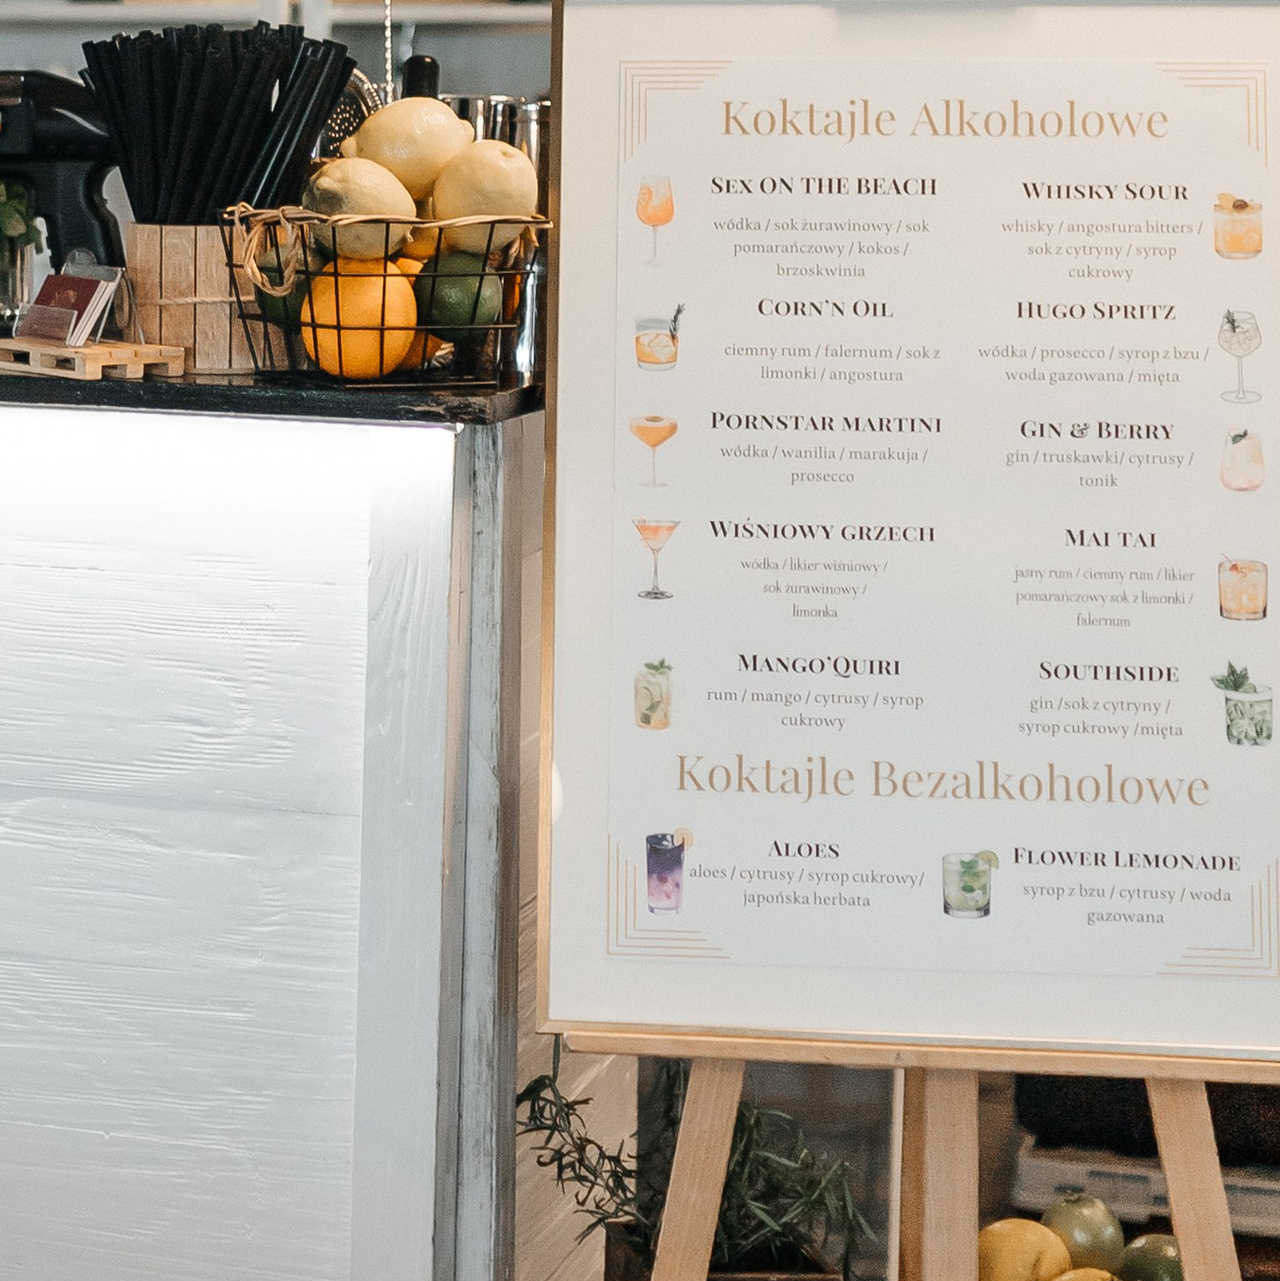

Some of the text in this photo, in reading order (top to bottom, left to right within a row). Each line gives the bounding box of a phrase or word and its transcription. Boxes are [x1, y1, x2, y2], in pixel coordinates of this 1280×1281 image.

[721, 97, 1169, 145] Koktajle Alkoholowe
[714, 217, 761, 231] wódka
[774, 218, 798, 231] sok
[801, 217, 893, 236] żurawinowy
[906, 219, 930, 233] sok
[1002, 219, 1054, 236] whisky
[1067, 221, 1142, 237] angostura
[1146, 221, 1193, 235] bitters
[733, 240, 845, 258] pomarańczowy
[858, 241, 900, 255] kokos
[1028, 241, 1052, 255] sok
[1066, 243, 1123, 260] cytryny
[1136, 245, 1177, 260] syrop
[777, 262, 865, 277] brzoskwinia
[1069, 264, 1134, 282] cukrowy
[725, 343, 778, 360] ciemny
[781, 346, 811, 357] rum
[825, 343, 892, 359] falernum
[906, 345, 930, 359] sok
[979, 344, 1027, 358] wódka
[1041, 348, 1105, 362] prosecco
[1118, 348, 1160, 363] syrop
[1174, 346, 1200, 360] bzu
[761, 365, 817, 380] limonki
[830, 368, 903, 384] angostura
[1006, 367, 1046, 381] woda
[1049, 371, 1125, 384] gazowana
[1138, 369, 1180, 386] mięta
[1070, 421, 1090, 439] &
[720, 443, 768, 458] wódka
[782, 445, 836, 460] wanilia
[849, 446, 919, 464] marakuja
[1006, 448, 1030, 465] gin
[1128, 451, 1184, 468] cytrusy
[791, 468, 855, 486] prosecco
[1079, 473, 1118, 487] tonik
[707, 689, 738, 701] rum
[751, 691, 802, 706] mango
[814, 692, 870, 709] cytrusy
[883, 694, 924, 710] syrop
[1030, 695, 1053, 713] gin
[1103, 700, 1162, 716] cytryny
[781, 712, 846, 731] cukrowy
[1019, 722, 1060, 738] syrop
[1064, 720, 1130, 739] cukrowy
[676, 753, 1210, 807] Koktajle Bezalkoholowe
[689, 864, 727, 879] aloes
[740, 867, 795, 884] cytrusy
[808, 871, 849, 886] syrop
[743, 889, 871, 907] japońska herbata
[1023, 883, 1065, 900] syrop
[1079, 883, 1106, 898] bzu
[1119, 887, 1176, 904] cytrusy
[1190, 888, 1231, 902] woda
[1087, 910, 1165, 926] gazowana
